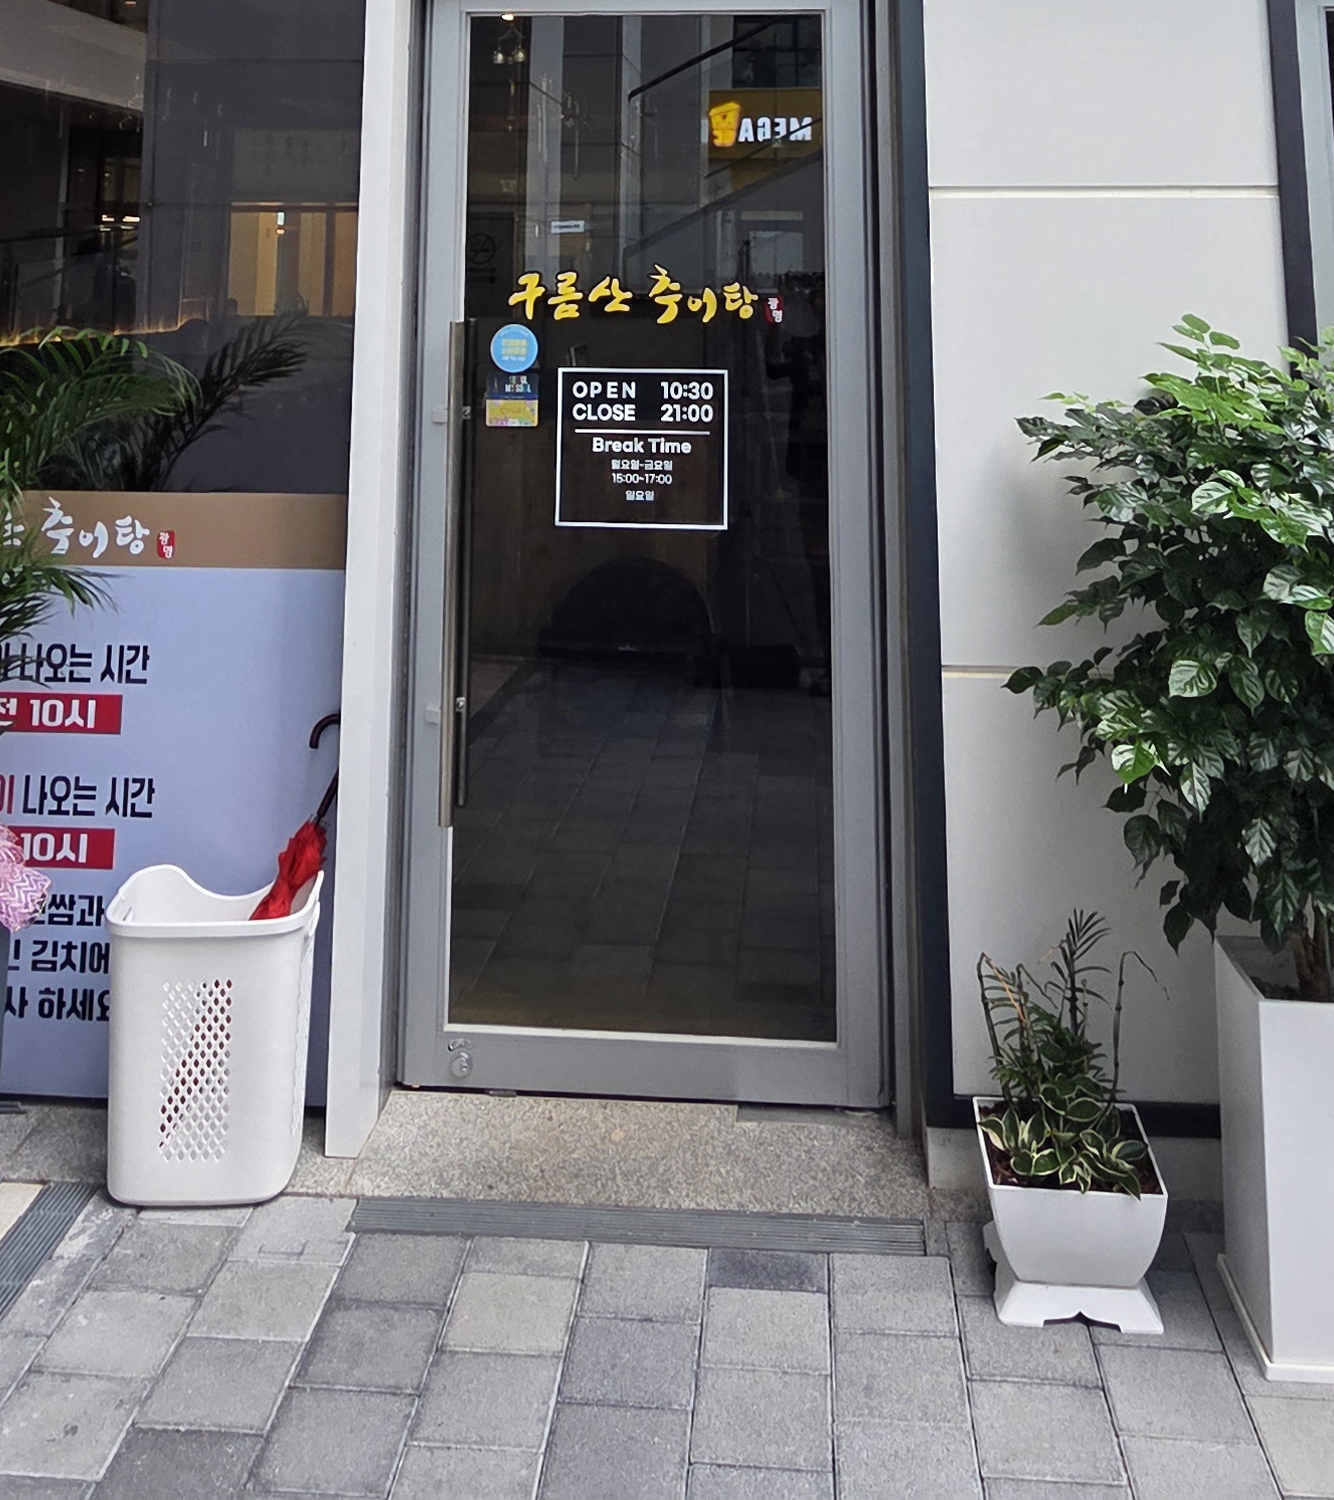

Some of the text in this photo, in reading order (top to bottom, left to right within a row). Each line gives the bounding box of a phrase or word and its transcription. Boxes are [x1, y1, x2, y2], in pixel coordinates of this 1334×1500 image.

[508, 271, 633, 321] 구름산
[648, 264, 759, 324] 추어탕
[572, 381, 714, 400] OPEN 10:30
[572, 403, 714, 422] CLOSE 21:00
[592, 437, 692, 454] Break Time
[19, 642, 93, 683] 나오는
[100, 644, 150, 684] 시간
[29, 699, 97, 729] 10시
[22, 774, 98, 817] 나오는
[105, 776, 156, 819] 시간
[32, 893, 105, 927] 쌈과
